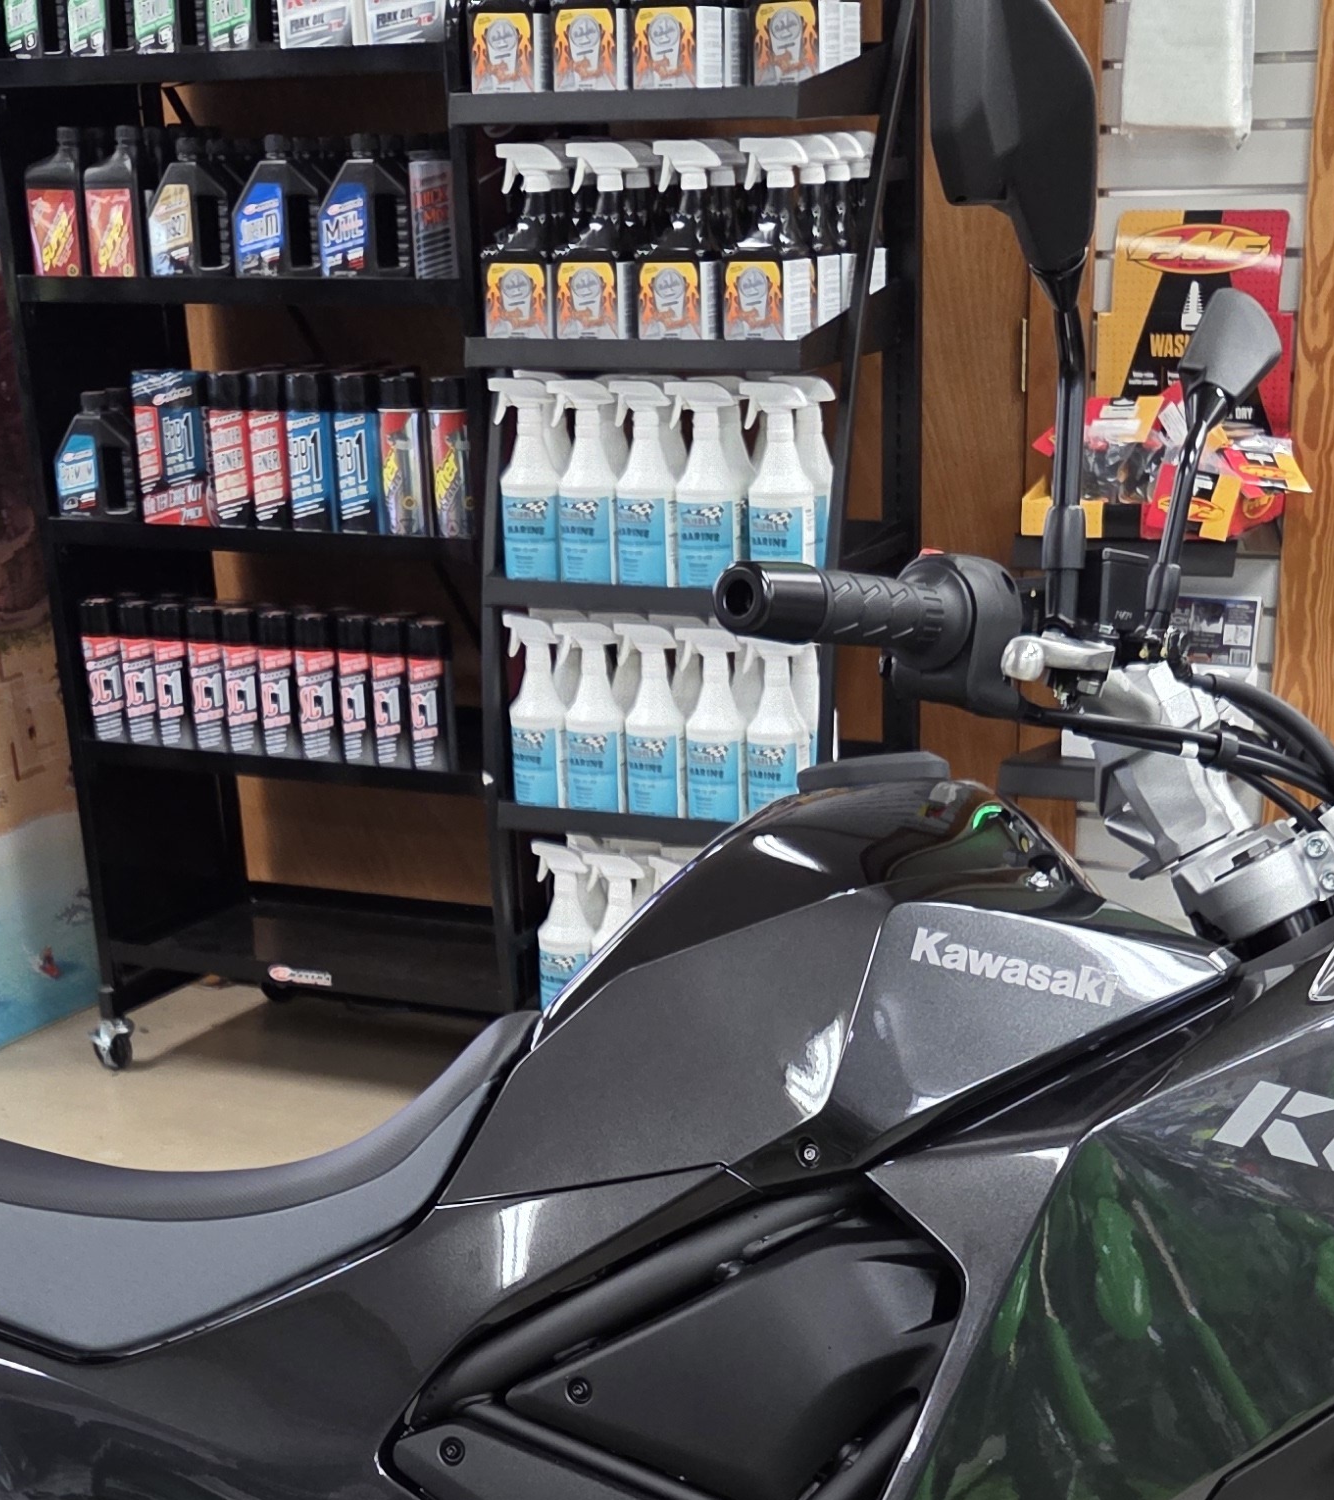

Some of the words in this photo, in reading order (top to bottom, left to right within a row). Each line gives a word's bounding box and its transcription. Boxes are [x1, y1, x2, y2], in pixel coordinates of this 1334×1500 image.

[1127, 231, 1271, 261] FMF
[1235, 406, 1254, 420] DRY
[910, 926, 1119, 1007] Kawasaki
